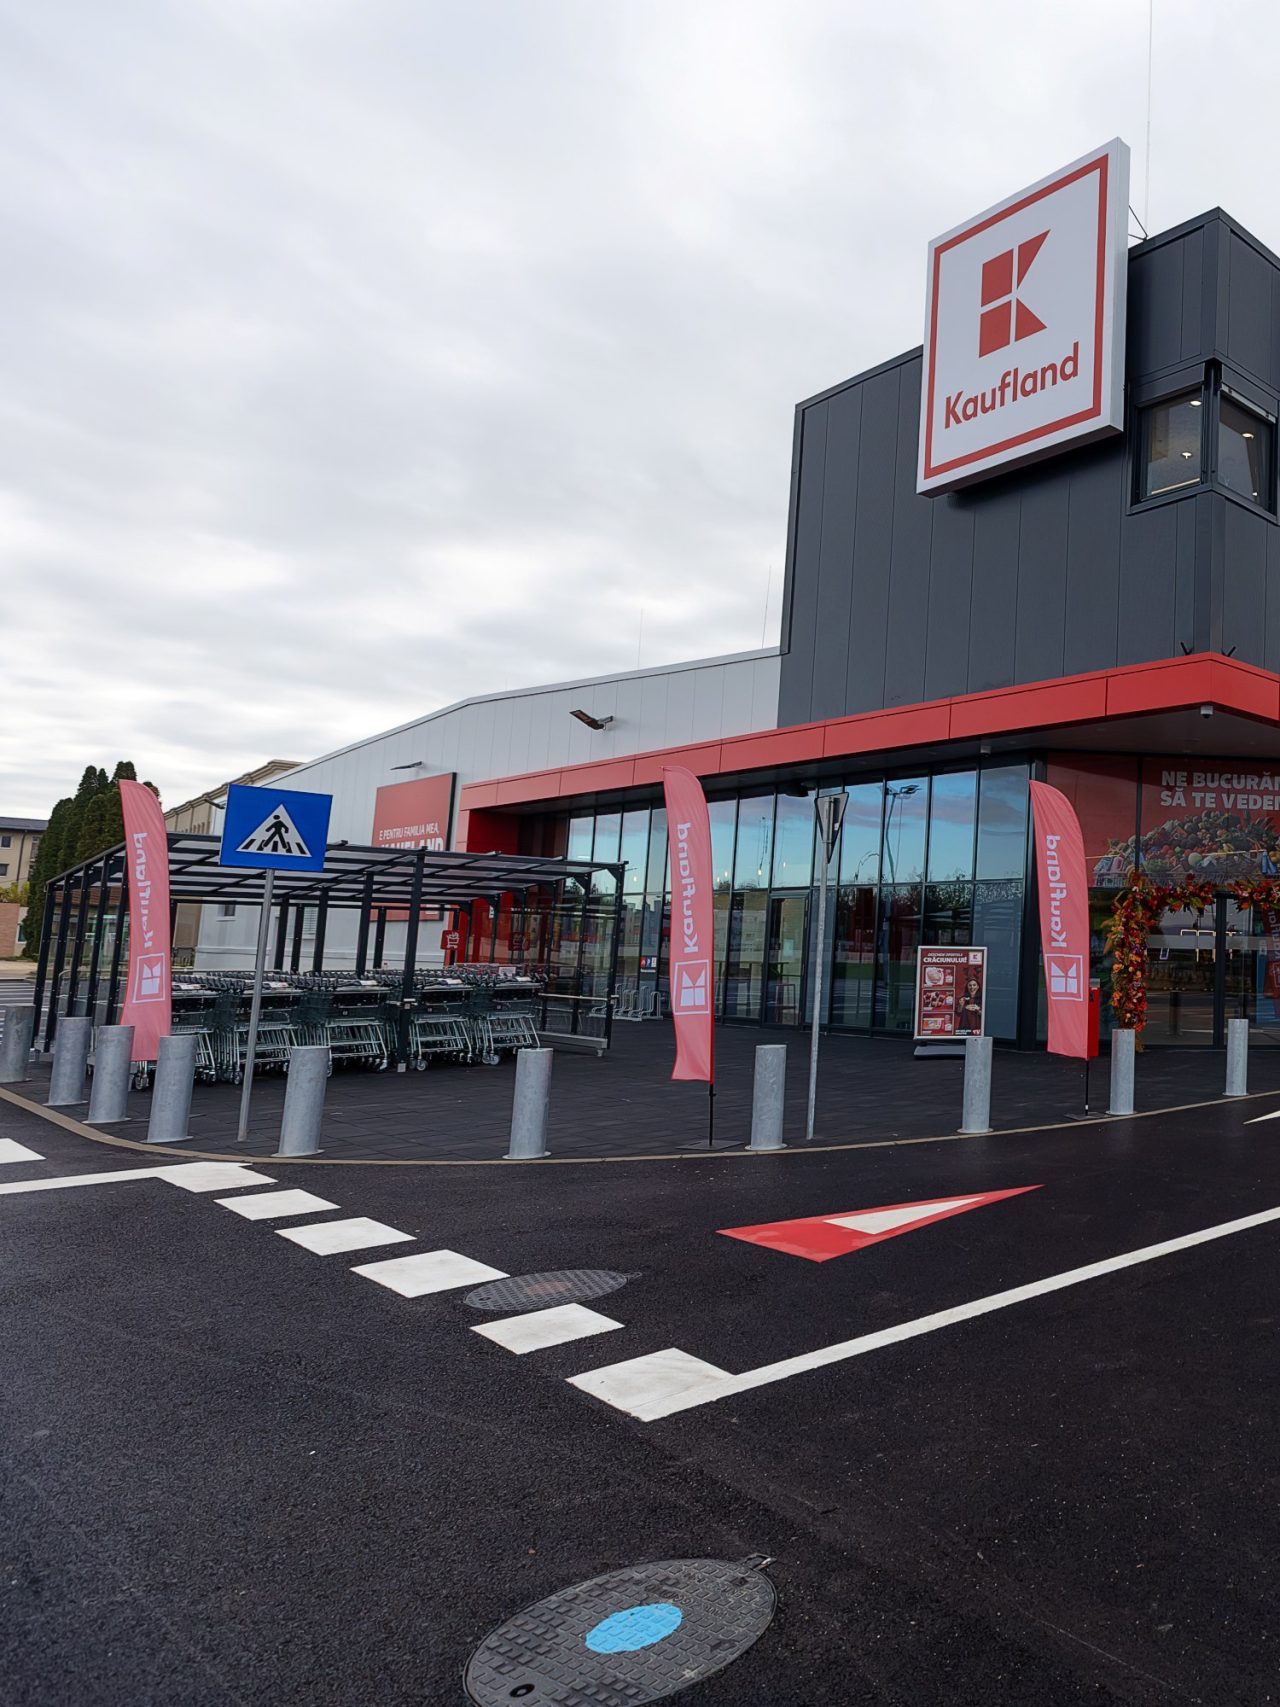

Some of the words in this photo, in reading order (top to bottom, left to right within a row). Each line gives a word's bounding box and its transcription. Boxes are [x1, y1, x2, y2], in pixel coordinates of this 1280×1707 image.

[944, 341, 1080, 430] Kaufland
[1161, 770, 1188, 787] NE
[1160, 787, 1186, 807] SĂ
[1191, 791, 1216, 808] TE
